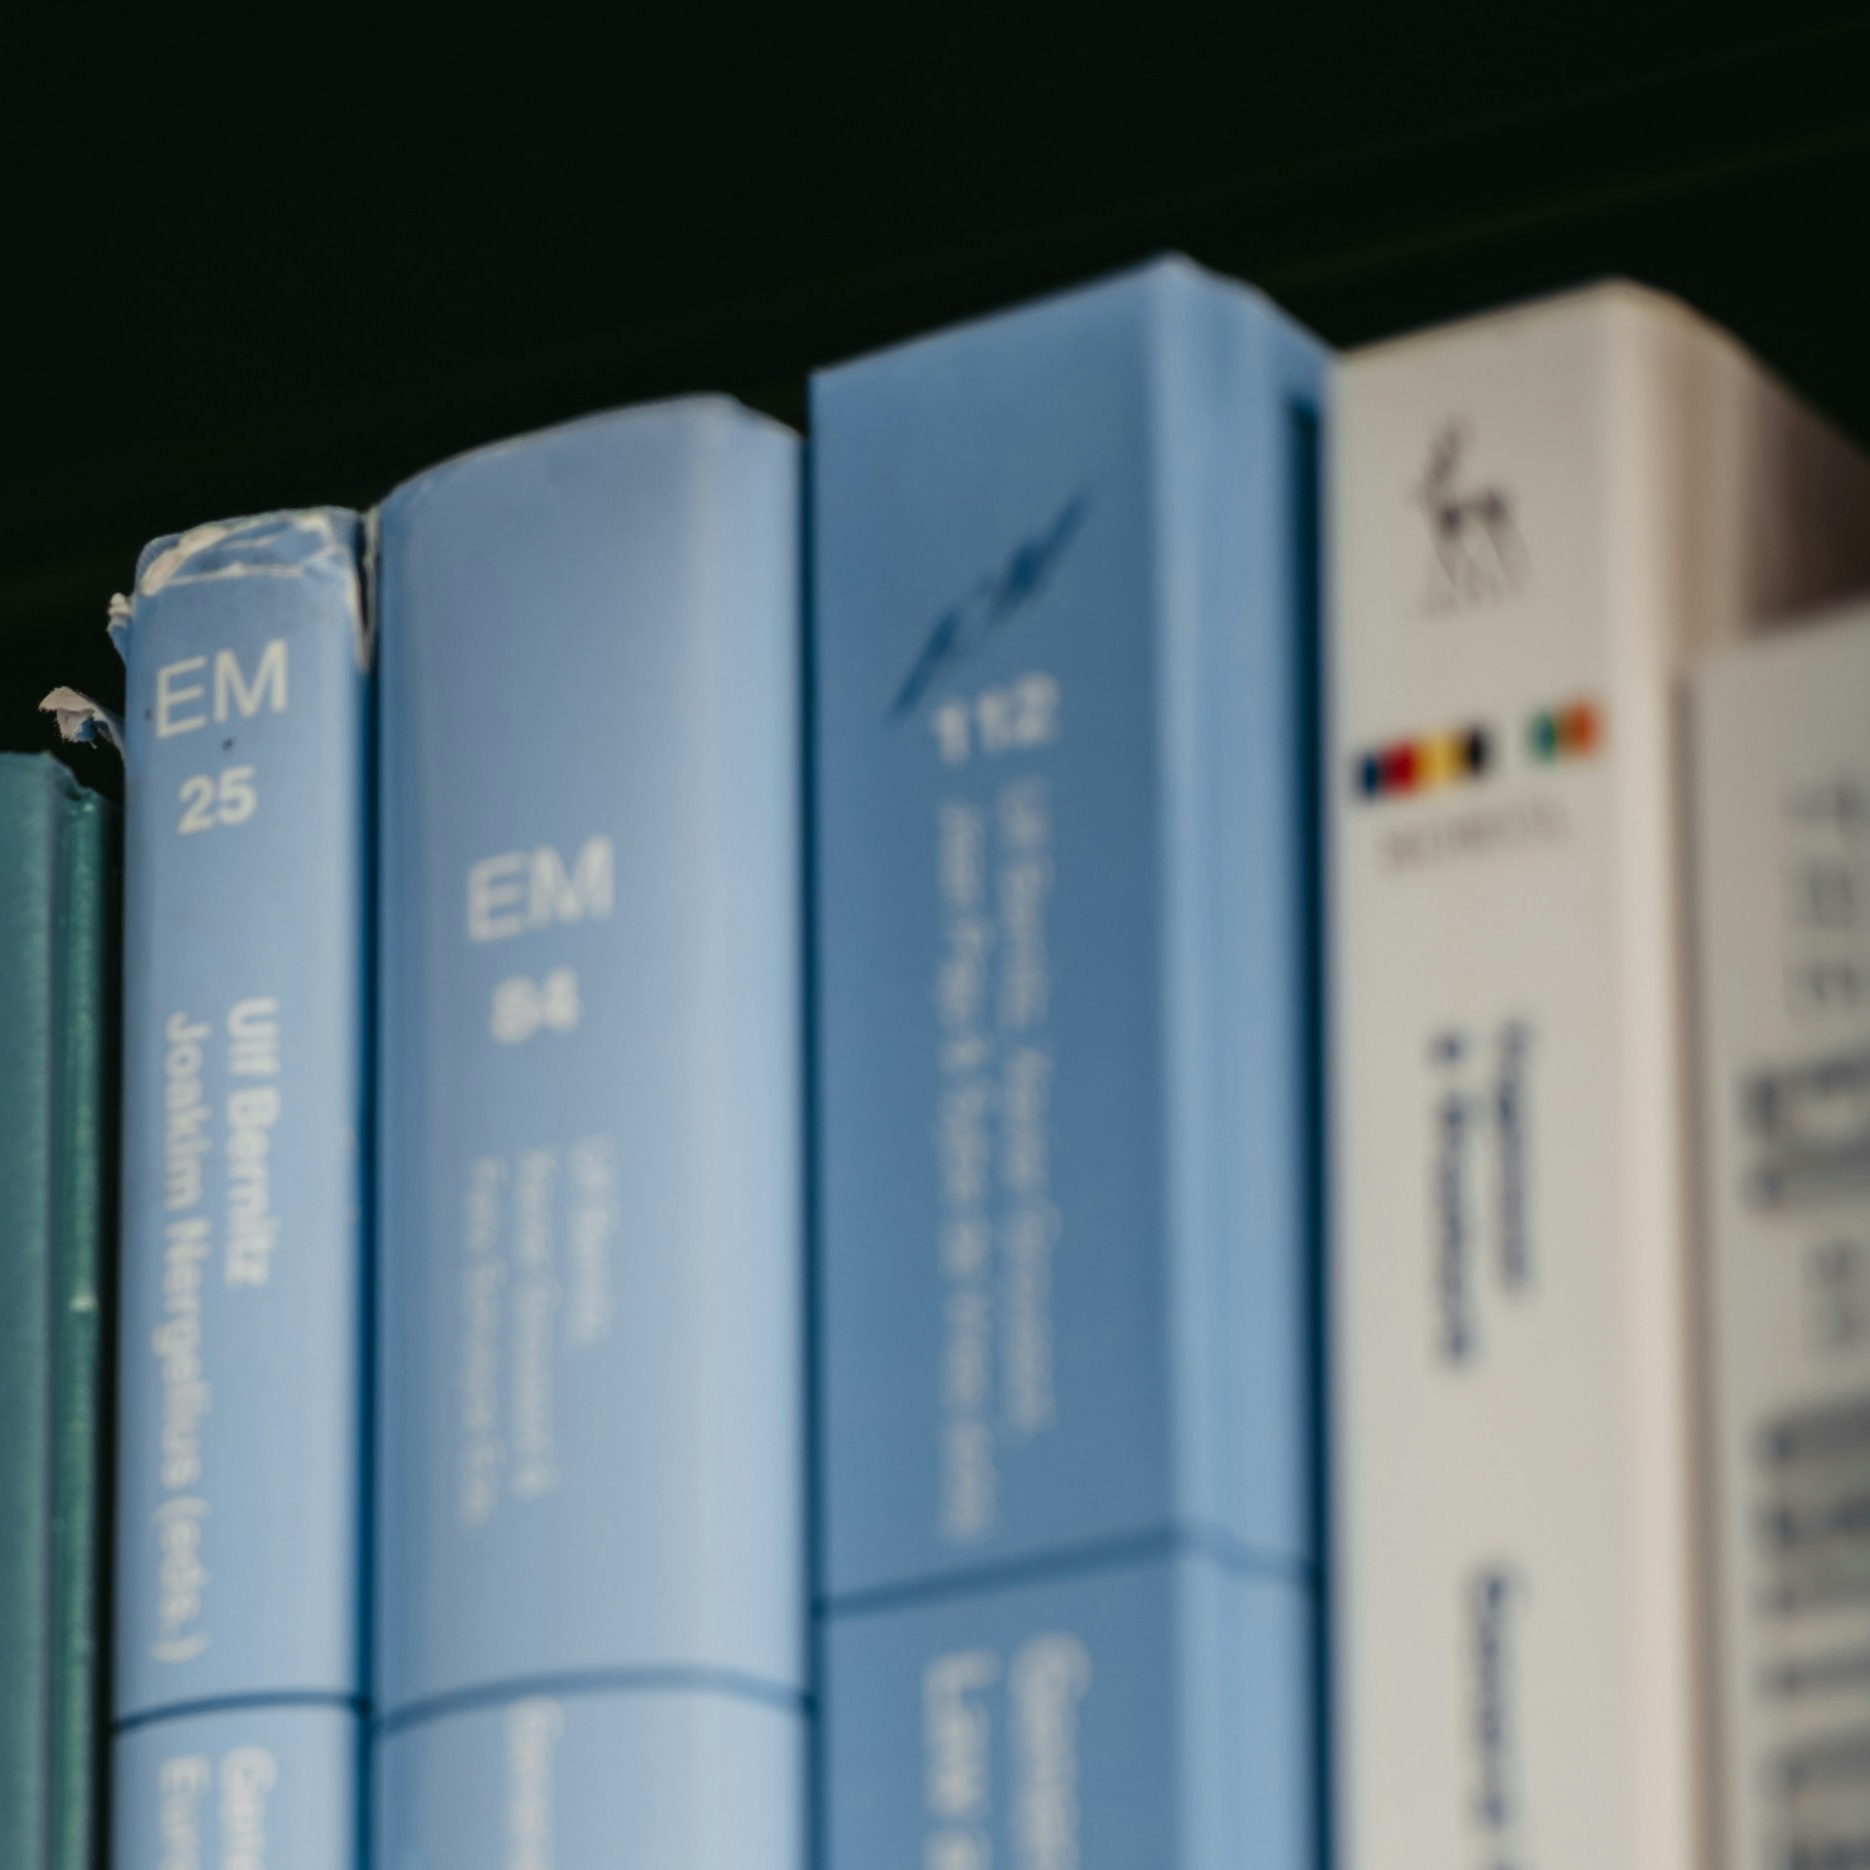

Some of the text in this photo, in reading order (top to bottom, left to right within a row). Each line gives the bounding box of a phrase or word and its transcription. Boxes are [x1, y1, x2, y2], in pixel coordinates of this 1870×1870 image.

[157, 639, 287, 739] EM
[178, 764, 257, 836] 25
[466, 833, 614, 942] EM
[227, 995, 280, 1076] Ulf
[165, 1008, 212, 1212] Joakim
